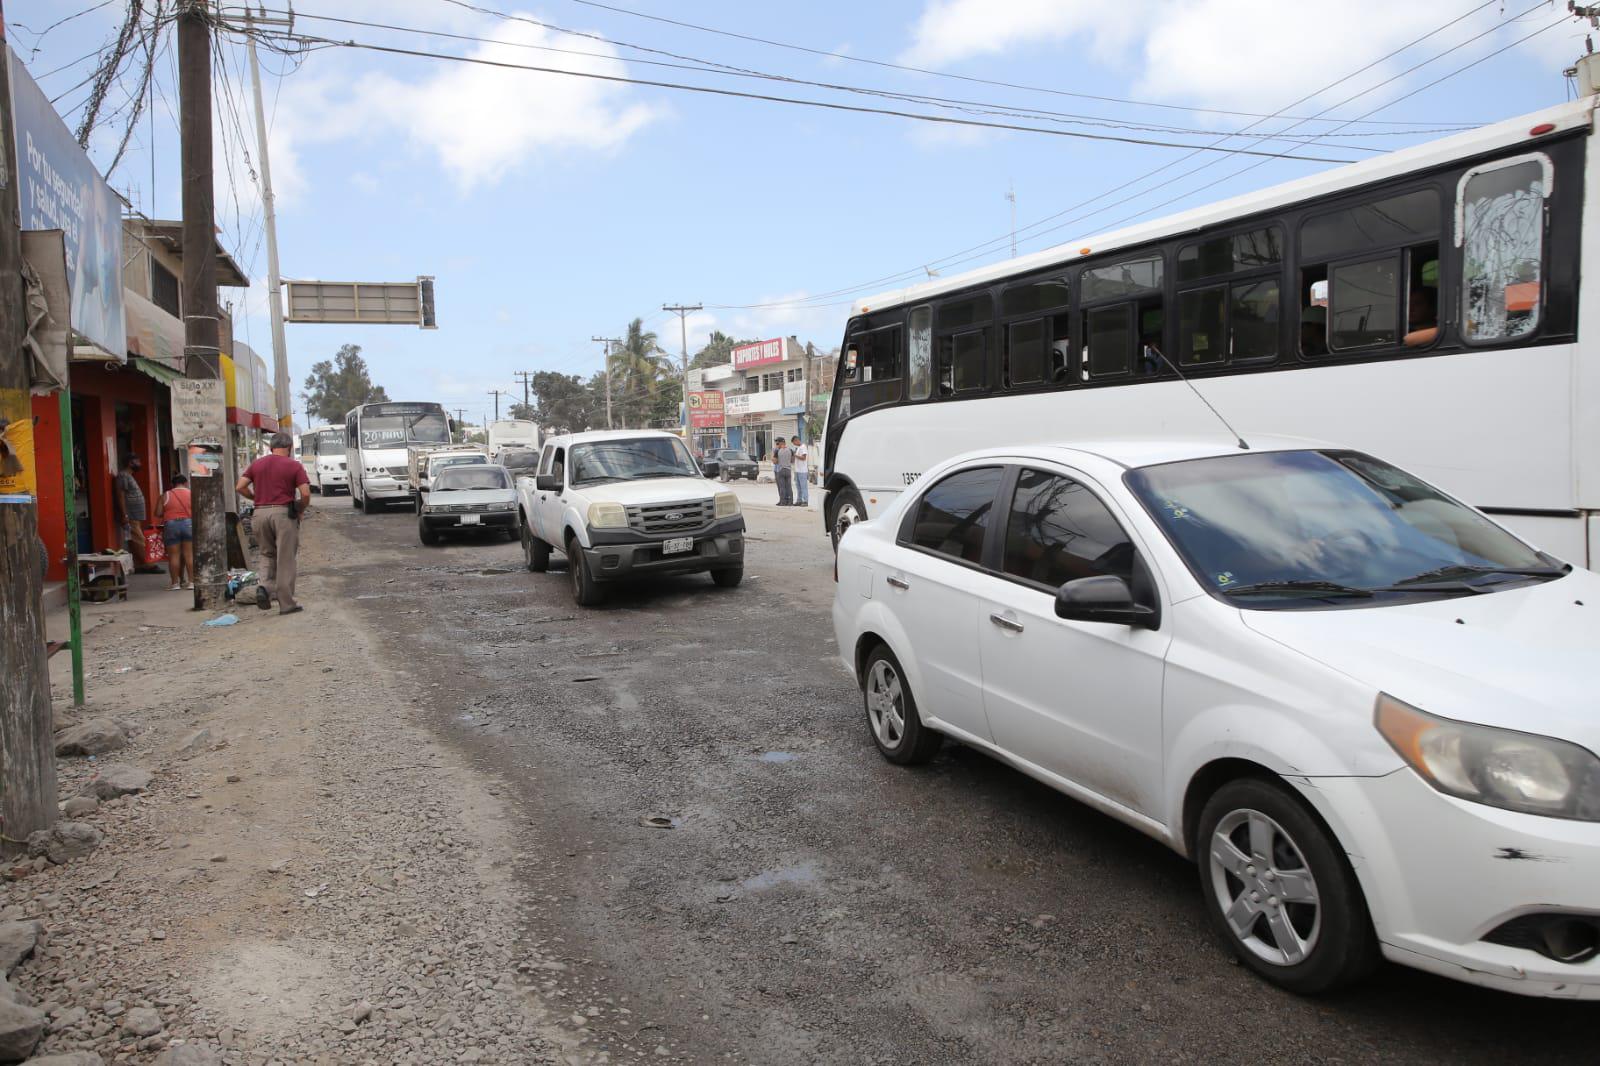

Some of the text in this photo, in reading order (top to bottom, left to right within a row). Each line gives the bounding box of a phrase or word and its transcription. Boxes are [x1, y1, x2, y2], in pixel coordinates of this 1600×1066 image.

[26, 131, 42, 174] Por
[42, 153, 52, 186] tu
[28, 175, 35, 209] Y
